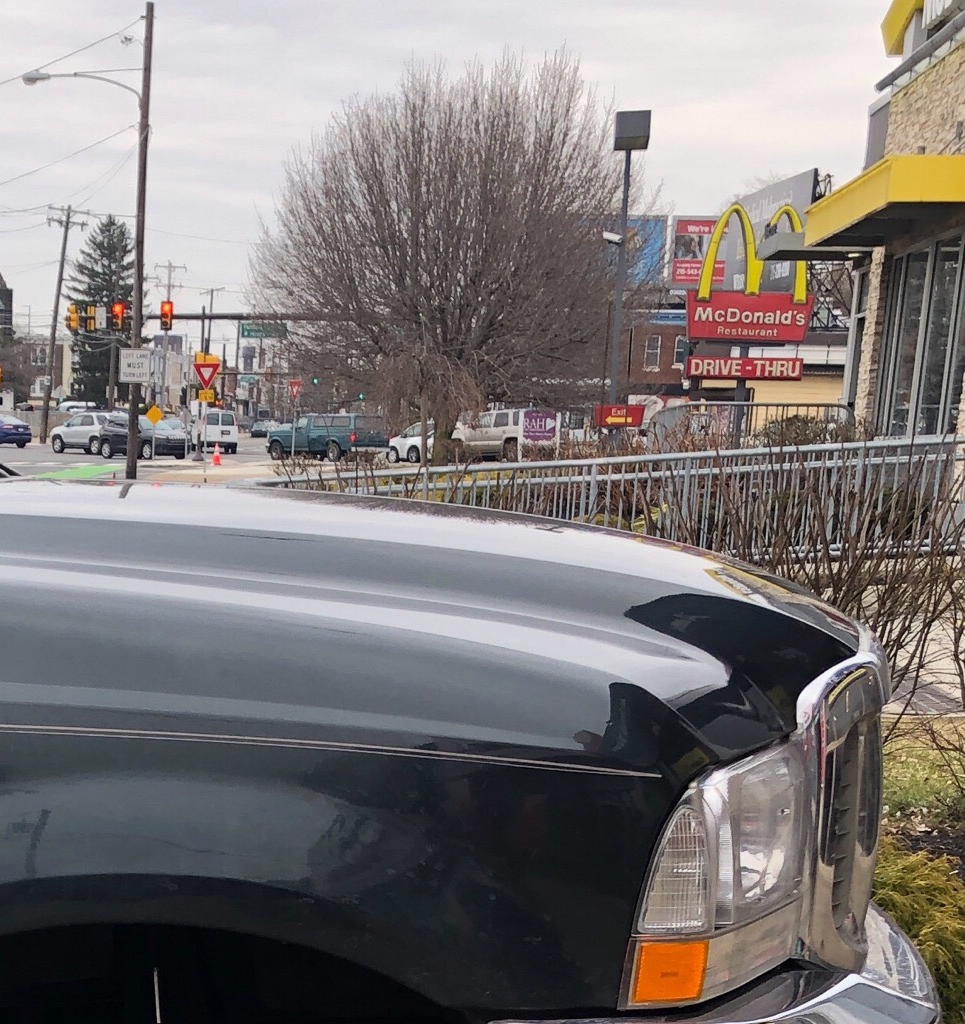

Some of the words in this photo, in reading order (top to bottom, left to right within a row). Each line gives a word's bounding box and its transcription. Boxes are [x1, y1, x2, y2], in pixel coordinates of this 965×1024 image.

[694, 307, 805, 326] McDonald's
[717, 326, 778, 337] Restaurant
[611, 407, 627, 416] Exit
